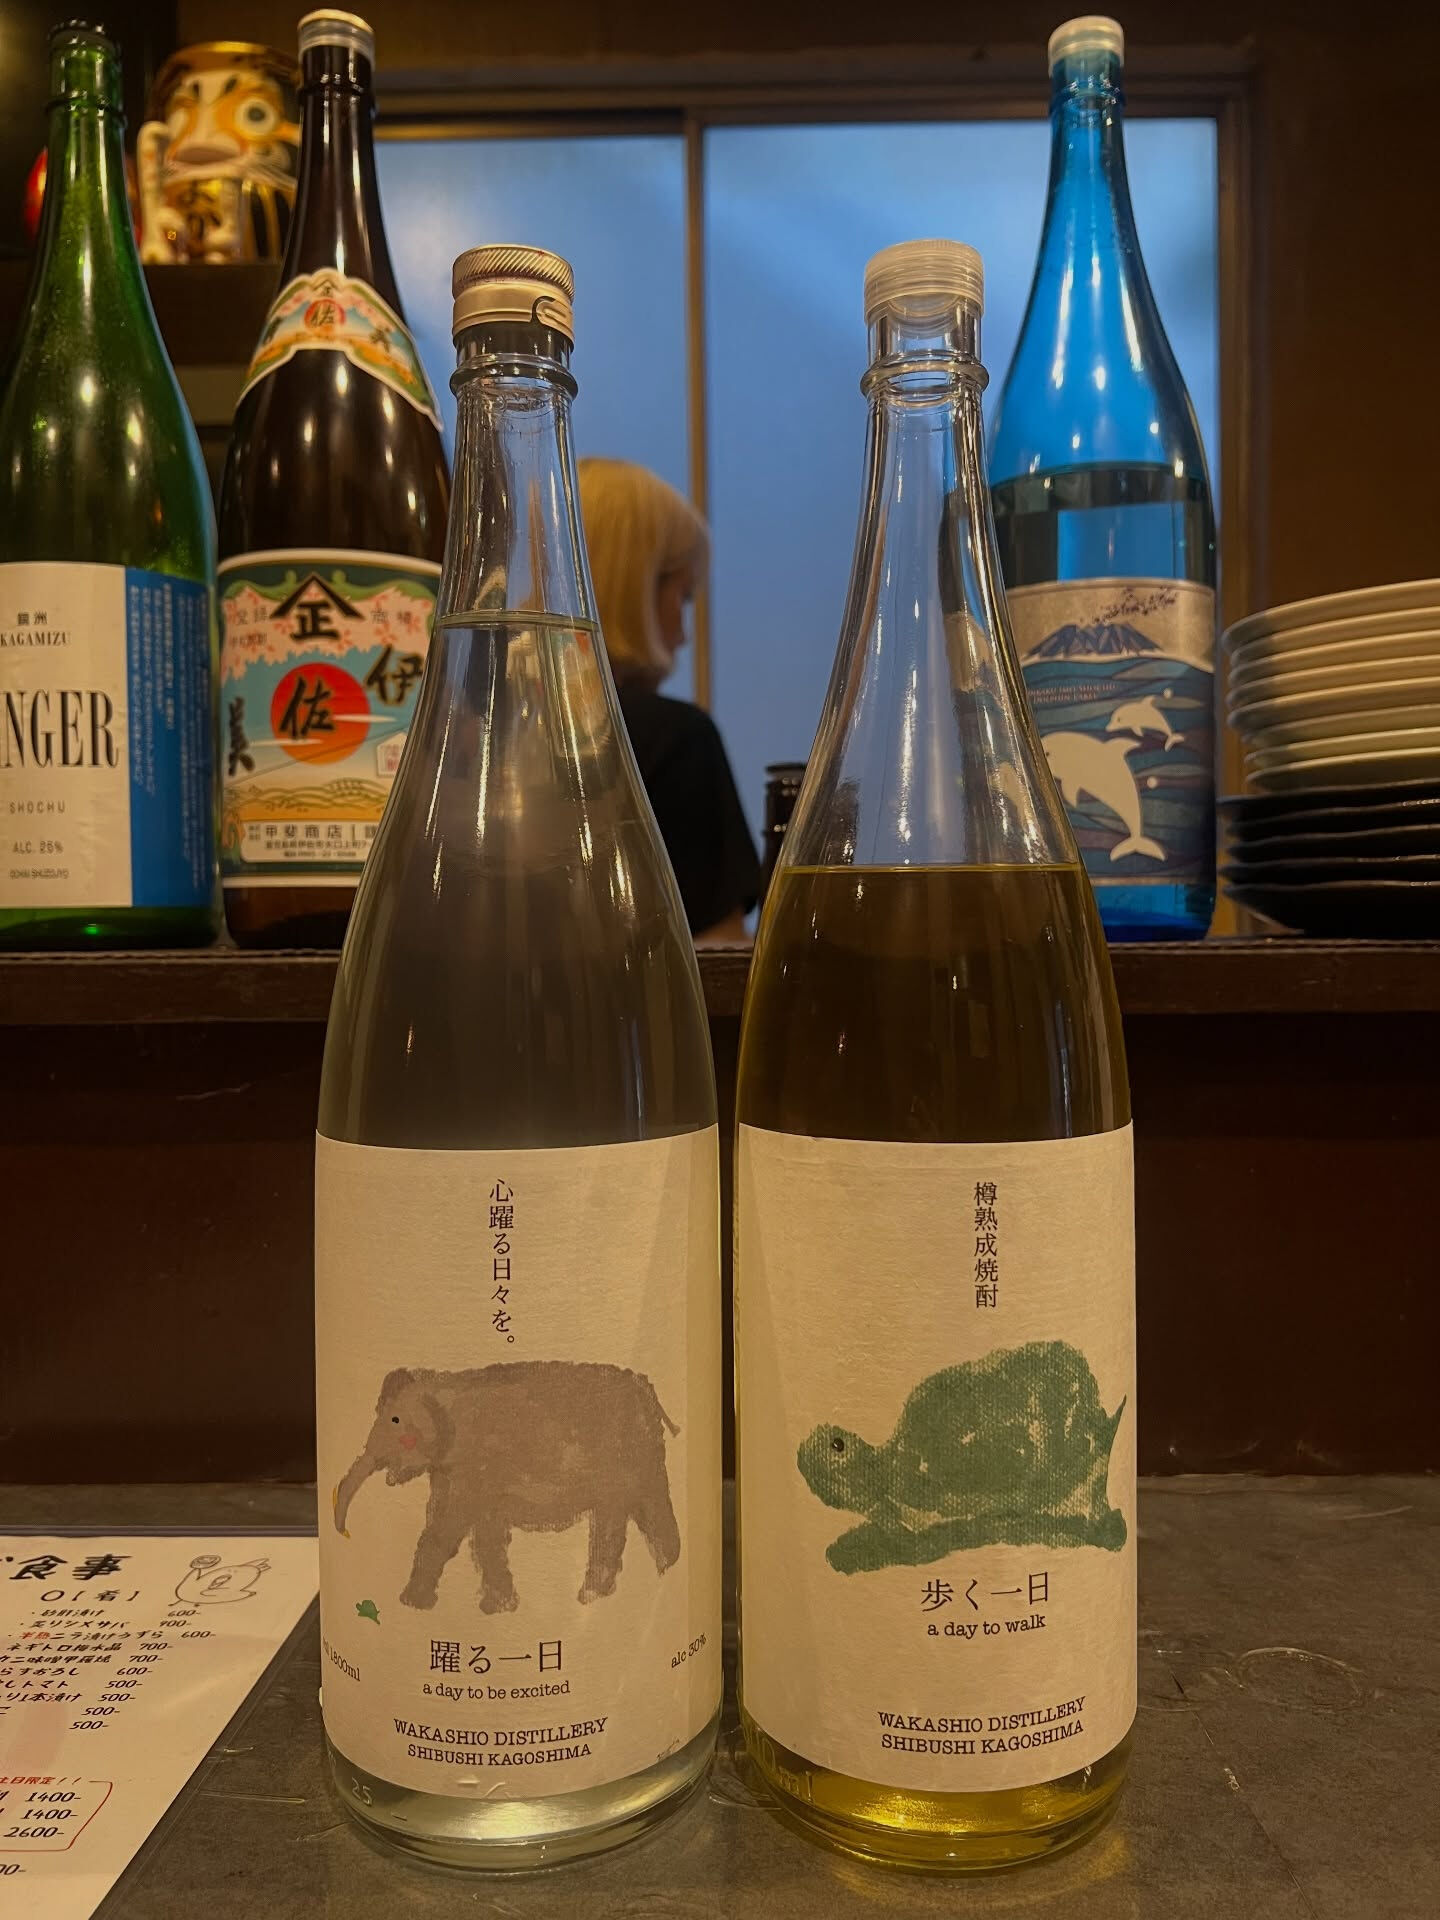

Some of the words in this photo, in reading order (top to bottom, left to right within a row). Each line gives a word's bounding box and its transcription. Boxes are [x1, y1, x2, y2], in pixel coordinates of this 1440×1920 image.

[291, 600, 340, 642] 正
[279, 676, 336, 740] 佐
[9, 801, 66, 814] SHOCHU
[973, 1181, 999, 1308] 樽熟成焼酎
[488, 1178, 515, 1344] 心躍る日々を。
[920, 1571, 1049, 1613] 歩く一日
[927, 1622, 939, 1637] a
[944, 1621, 979, 1640] day
[983, 1620, 1001, 1635] to
[1005, 1613, 1047, 1634] walk
[329, 1646, 361, 1682] 1800ml
[429, 1638, 563, 1675] 躍る一日
[671, 1650, 687, 1669] alc
[688, 1632, 707, 1657] 30%
[0, 1679, 69, 1689] しトマト
[104, 1679, 144, 1689] 500-
[116, 1666, 153, 1676] 600-
[97, 1692, 137, 1702] 500-
[422, 1682, 433, 1696] a
[435, 1681, 465, 1701] day
[468, 1685, 484, 1700] to
[488, 1685, 507, 1700] be
[510, 1679, 571, 1699] excited
[81, 1706, 121, 1716] 500-
[877, 1711, 984, 1733] WAKASHIO
[987, 1695, 1086, 1733] DISTILLERY
[69, 1720, 110, 1730] 500-
[393, 1717, 489, 1746] WAKASHIO
[493, 1716, 609, 1746] DISTILLERY
[881, 1735, 976, 1755] SHIBUSHI
[980, 1719, 1084, 1754] KAGOSHIMA
[407, 1743, 484, 1766] SHIBUSHI
[487, 1743, 592, 1766] KAGOSHIMA
[25, 1791, 82, 1803] 1400-
[20, 1808, 79, 1820] 1400-
[3, 1826, 65, 1838] 2600-
